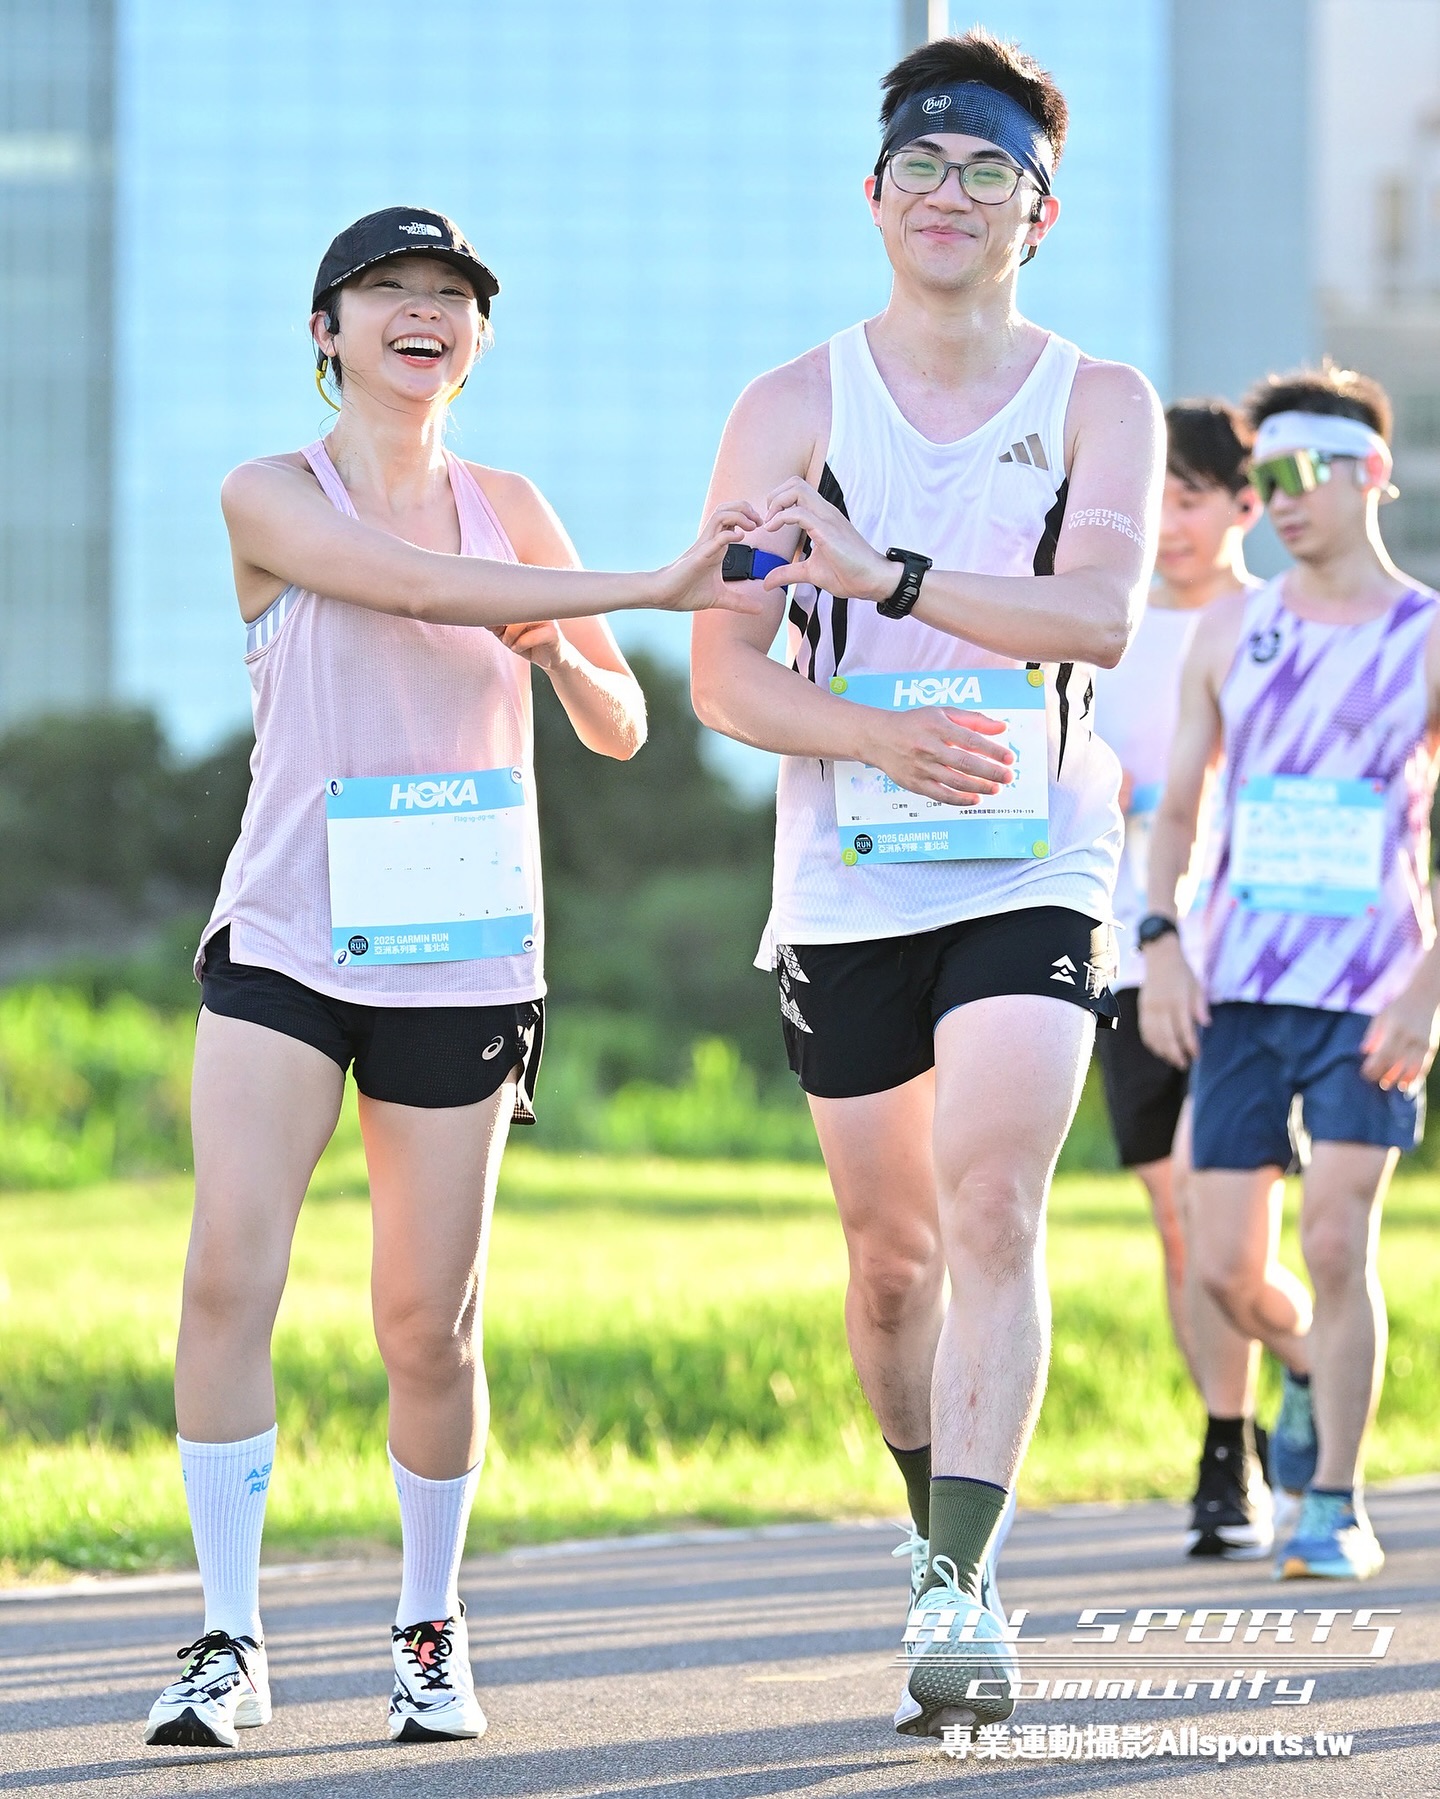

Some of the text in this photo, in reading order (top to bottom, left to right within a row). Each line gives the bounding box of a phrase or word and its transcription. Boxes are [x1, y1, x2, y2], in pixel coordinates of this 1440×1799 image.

[926, 97, 947, 111] Buff
[1068, 508, 1131, 527] TOGETHER
[1068, 518, 1087, 530] WE
[1088, 518, 1111, 527] FLY
[893, 676, 983, 707] HOKA
[389, 779, 479, 811] HOKA
[877, 831, 949, 844] 2025 GARMIN RUN
[856, 841, 871, 849] RUN
[374, 936, 395, 945] 2025
[396, 934, 430, 944] GARMIN
[431, 933, 449, 942] RUN
[350, 942, 367, 951] RUN
